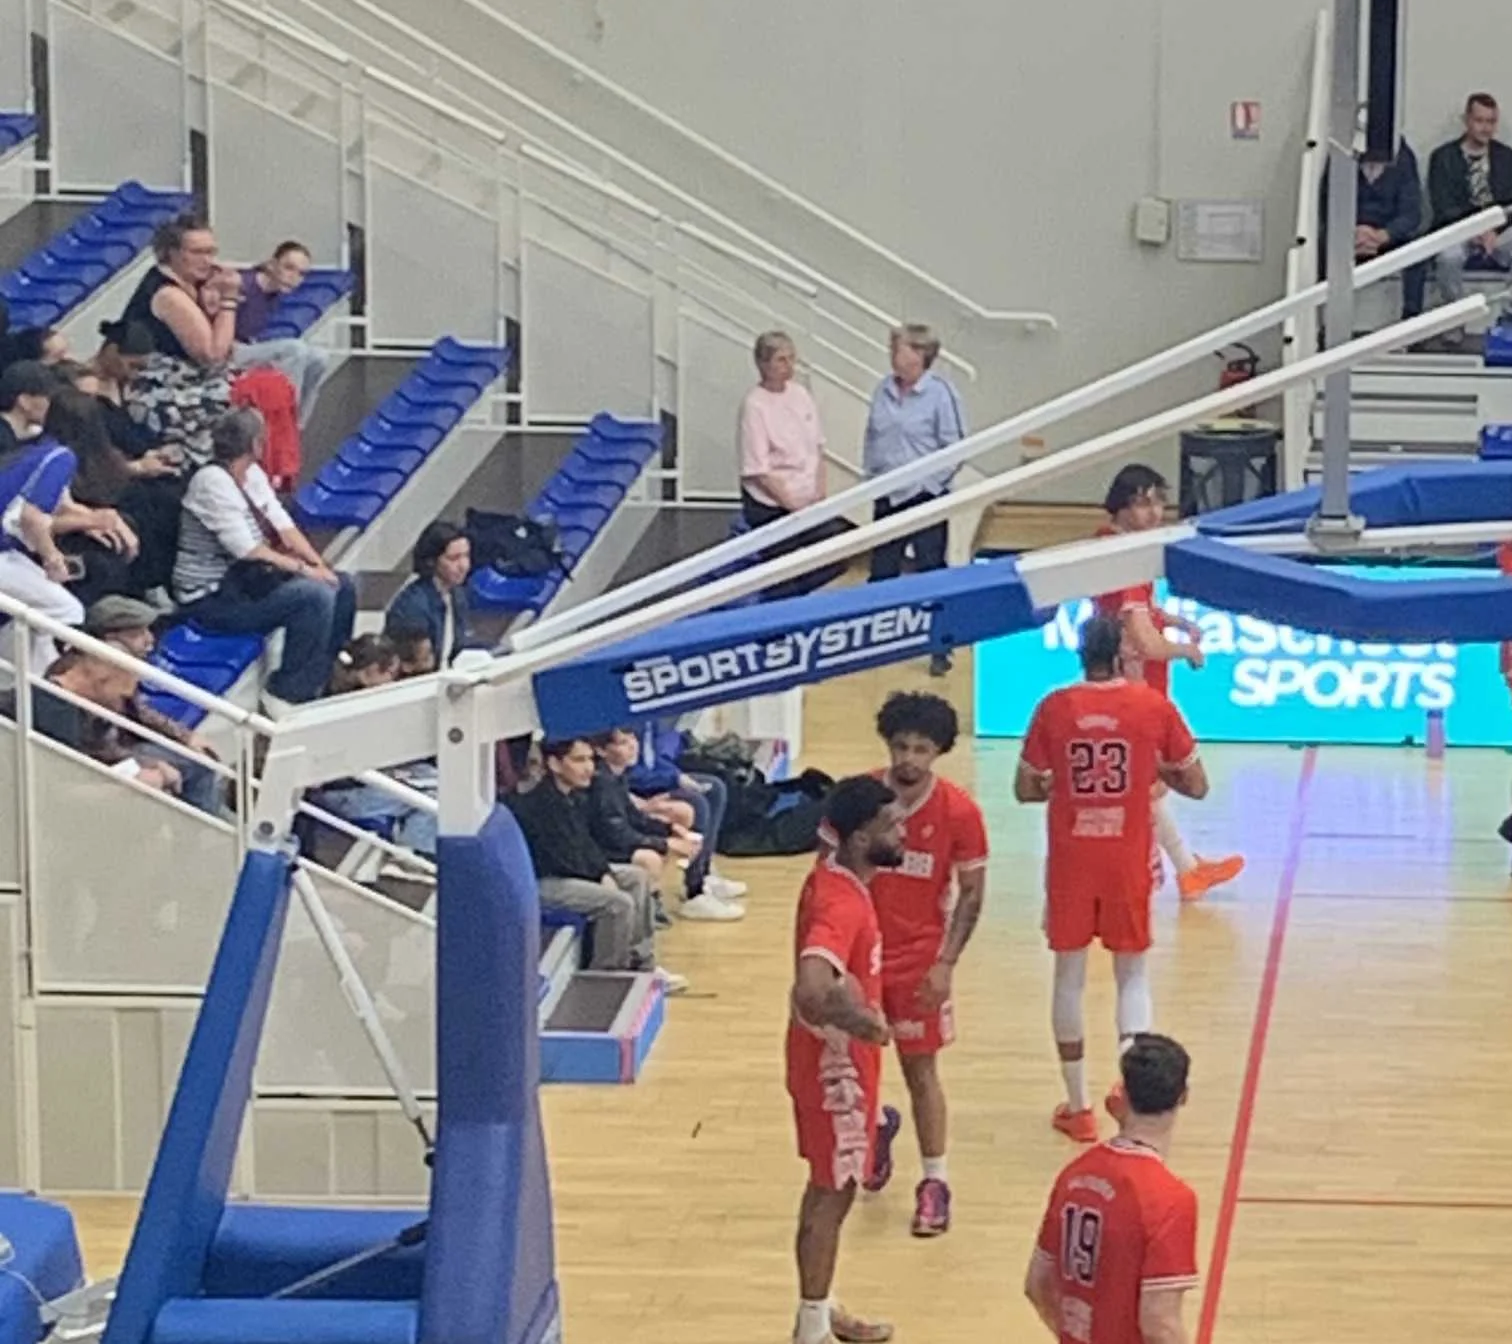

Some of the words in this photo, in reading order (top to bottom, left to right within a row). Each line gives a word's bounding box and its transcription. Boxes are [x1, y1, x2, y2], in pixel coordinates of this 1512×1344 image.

[622, 604, 934, 702] SPORTSYSTEM
[1229, 657, 1457, 709] SPORTS
[1066, 739, 1131, 798] 23
[1061, 1201, 1102, 1288] 19
